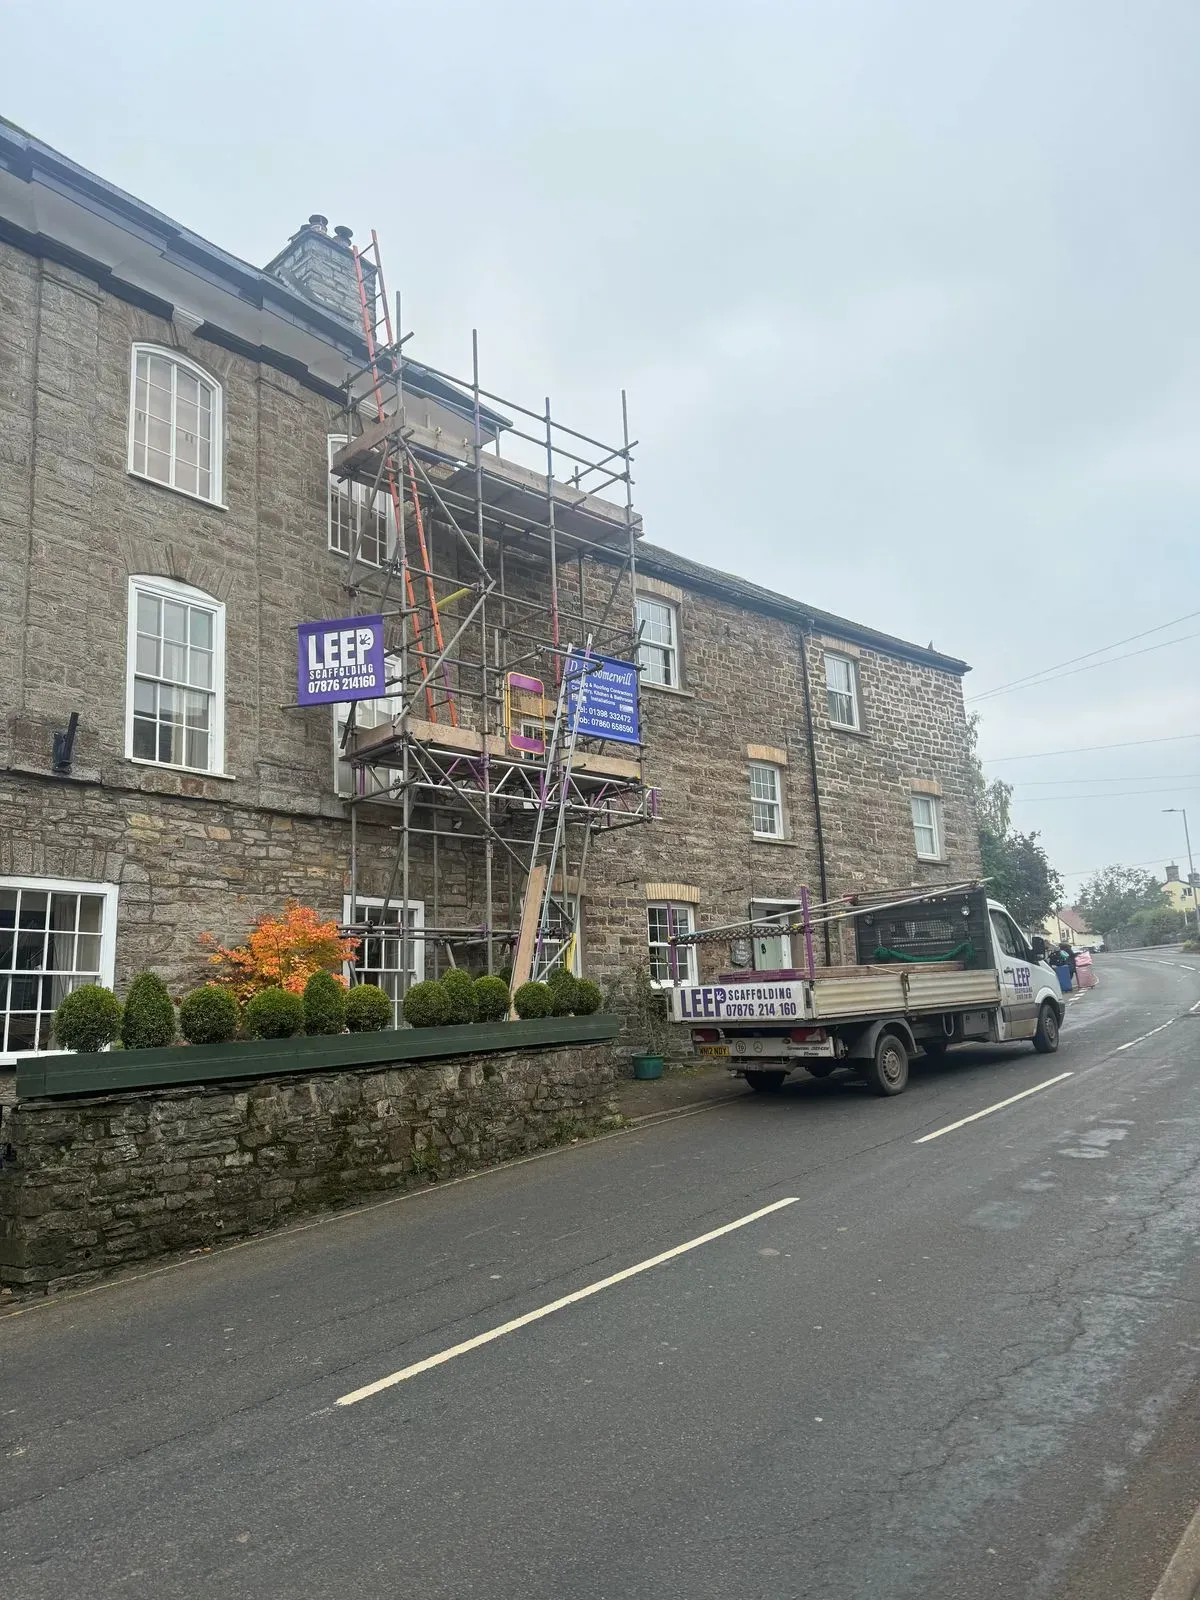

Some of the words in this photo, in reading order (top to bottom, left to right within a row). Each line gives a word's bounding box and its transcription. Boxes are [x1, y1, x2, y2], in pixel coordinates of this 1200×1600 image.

[308, 628, 374, 670] LEEP
[309, 664, 373, 679] SCAFFOLDING
[308, 679, 340, 694] 07876
[341, 674, 376, 690] 214160
[609, 687, 633, 698] Contractors
[609, 711, 632, 723] 332472
[680, 987, 727, 1018] LEEP
[728, 987, 792, 1001] SCAFFOLDING
[726, 1003, 754, 1017] 07876
[758, 1003, 775, 1016] 214
[779, 1002, 797, 1016] 160
